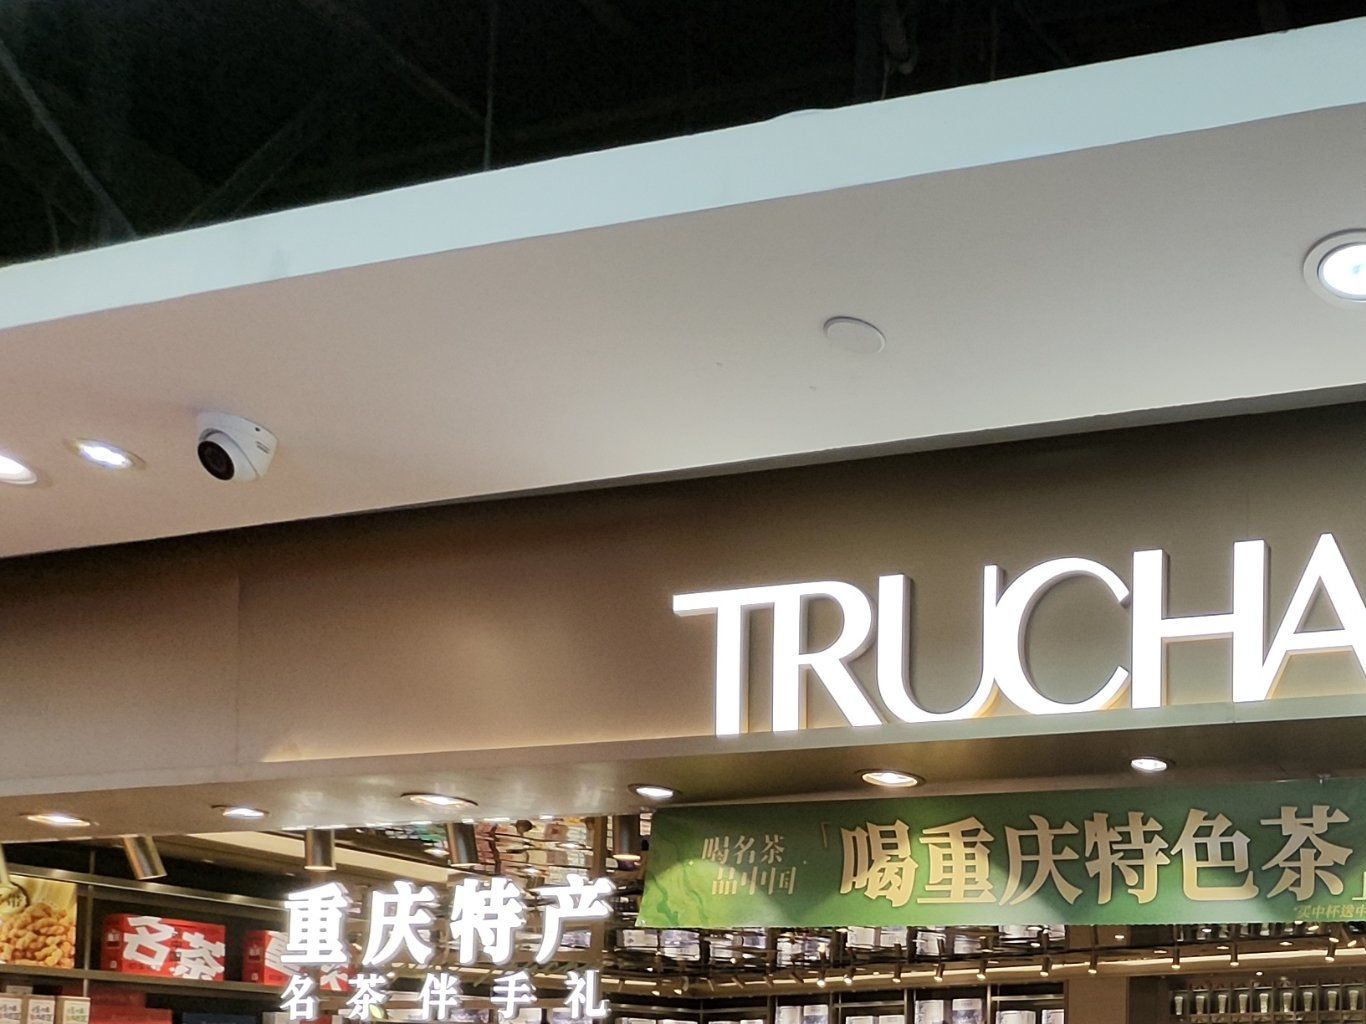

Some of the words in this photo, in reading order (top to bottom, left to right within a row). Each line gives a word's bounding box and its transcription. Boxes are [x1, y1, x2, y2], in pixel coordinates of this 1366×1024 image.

[702, 834, 785, 864] 喝名茶
[123, 915, 226, 981] 名茶
[281, 875, 615, 967] 重庆特产
[280, 970, 610, 1022] 名茶伴手礼
